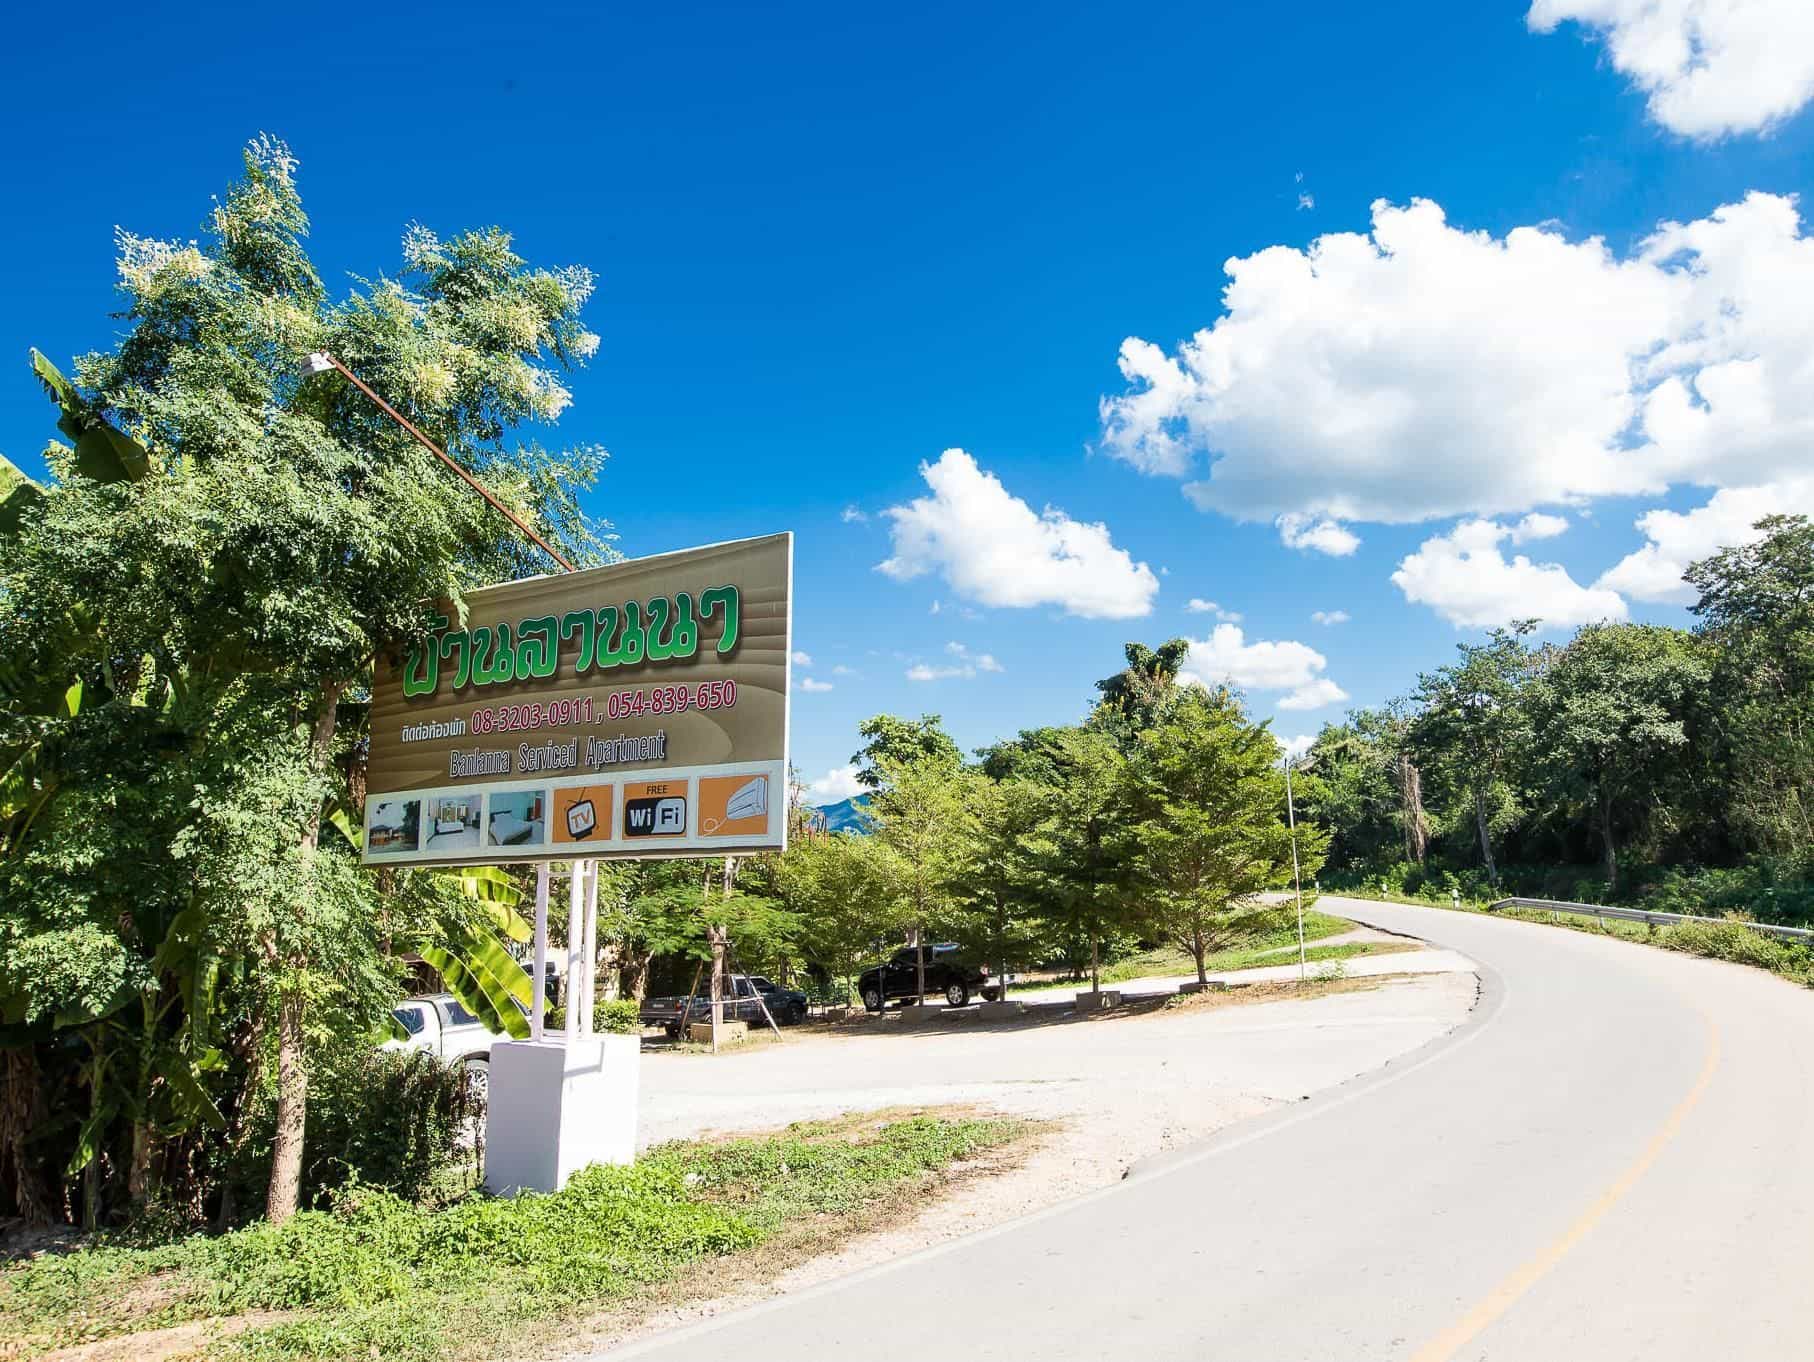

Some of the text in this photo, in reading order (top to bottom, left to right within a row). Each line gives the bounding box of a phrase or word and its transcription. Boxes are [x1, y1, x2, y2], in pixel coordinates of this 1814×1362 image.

[401, 717, 466, 743] ติดต่อห้องพัก
[608, 679, 737, 720] 054-839-650
[450, 729, 665, 778] Banlanna Serviced Apartment
[646, 784, 669, 795] FREE
[571, 808, 591, 829] TV
